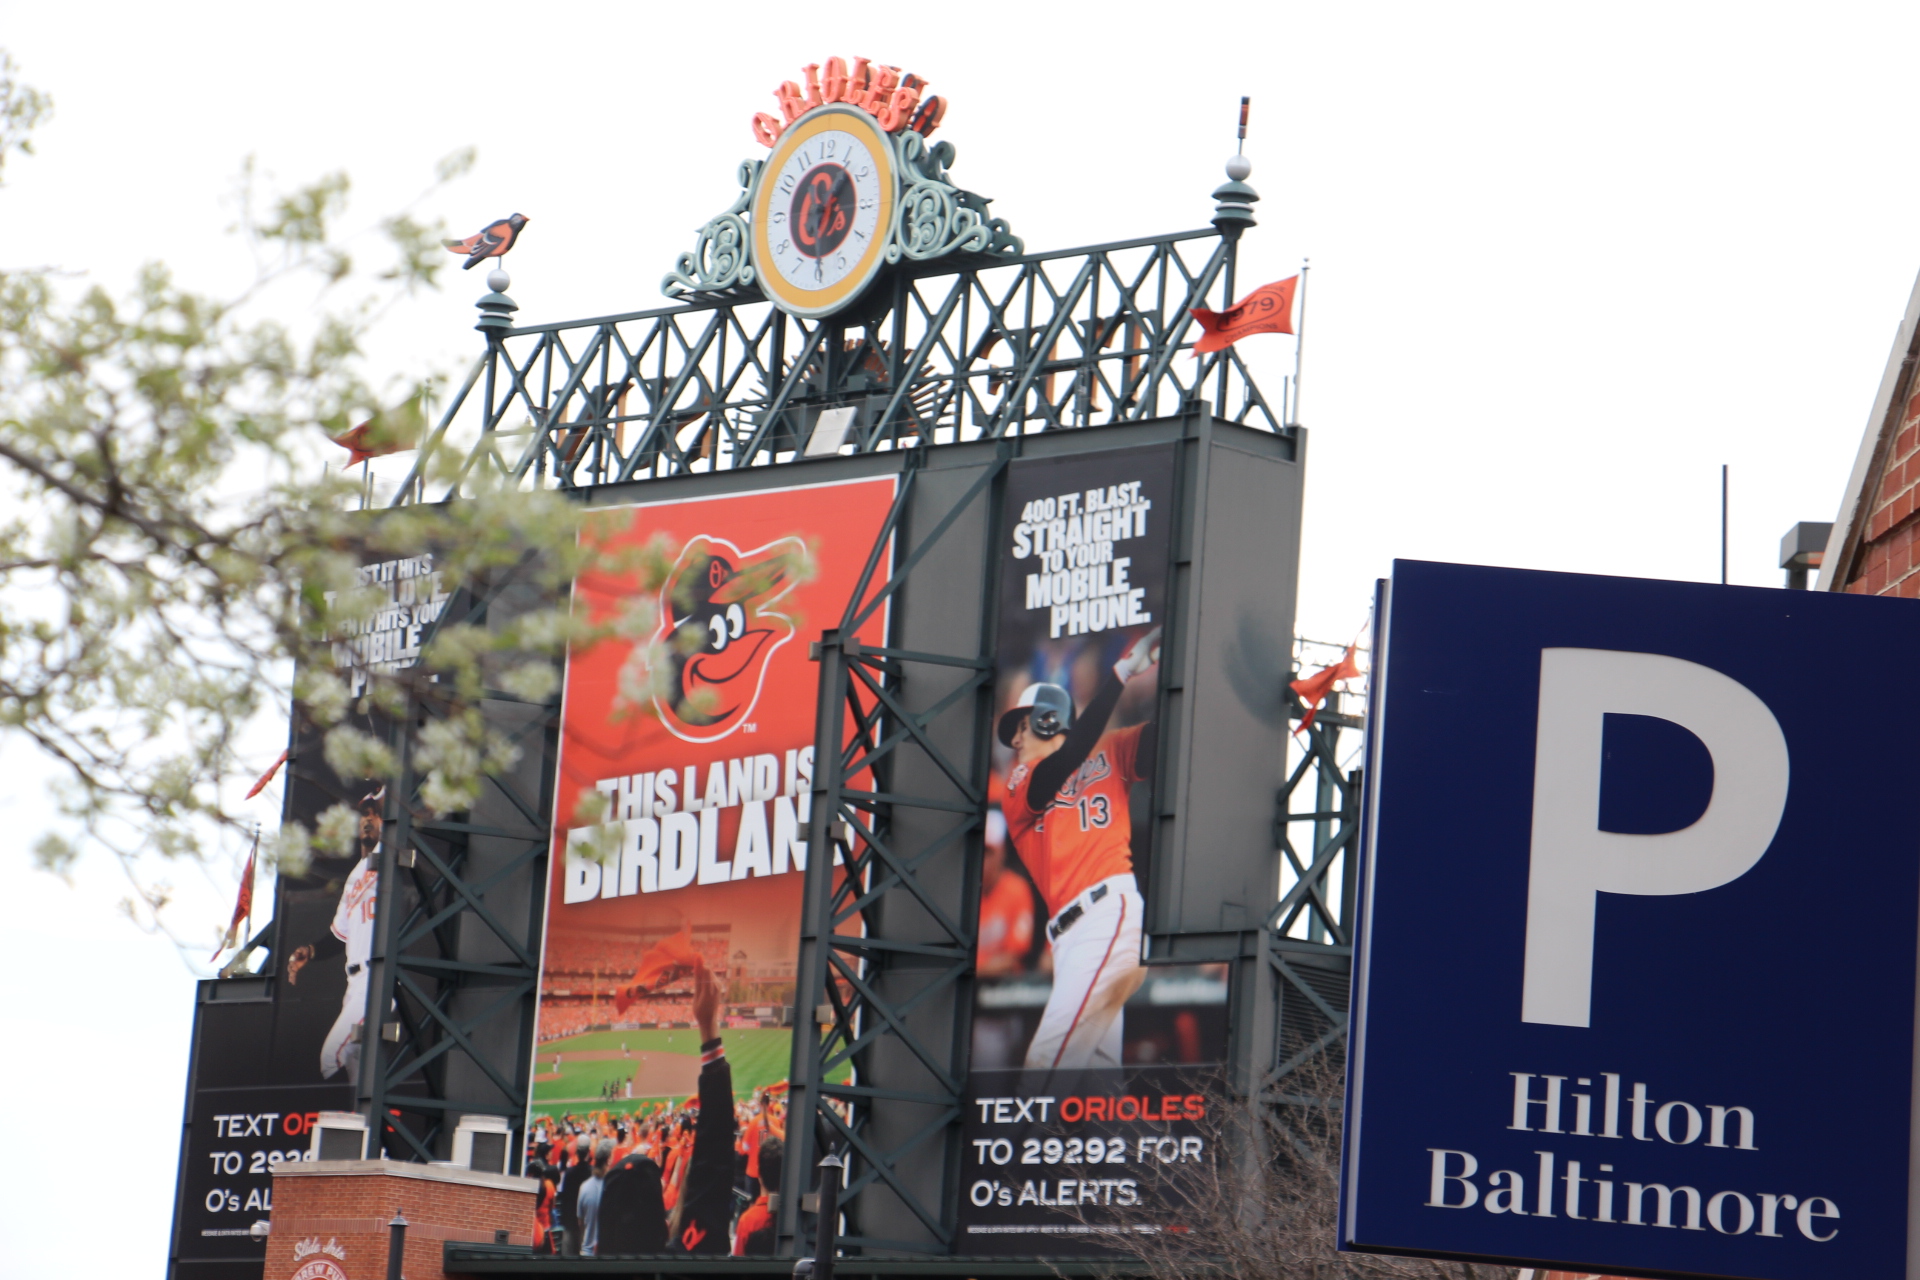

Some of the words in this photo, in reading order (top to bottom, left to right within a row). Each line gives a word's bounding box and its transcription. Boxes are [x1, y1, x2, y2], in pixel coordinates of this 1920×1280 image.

[752, 56, 920, 148] ORIOLES
[797, 150, 812, 172] 11
[819, 139, 836, 160] 12
[780, 174, 795, 196] 10
[855, 165, 869, 183] 2
[773, 210, 787, 224] 9
[858, 198, 873, 210] 3
[776, 239, 790, 255] 8
[853, 228, 866, 240] 4
[791, 256, 805, 275] 7
[836, 251, 847, 271] 5
[1021, 496, 1056, 524] 400
[1057, 492, 1084, 519] FT.
[1085, 480, 1146, 514] BLAST.
[1012, 499, 1151, 560] STRAIGHT
[398, 553, 433, 580] HITS
[1040, 549, 1064, 574] TO
[1066, 540, 1114, 570] YOUR
[1025, 556, 1131, 611] MOBILE
[375, 606, 410, 633] HITS
[412, 600, 447, 625] YOU
[1050, 587, 1151, 639] PHONE.
[743, 723, 758, 734] TM
[596, 768, 678, 824] THIS
[683, 752, 779, 812] LAND
[785, 745, 816, 799] IS
[1078, 792, 1112, 832] 13
[1521, 646, 1791, 1028] P
[976, 1096, 1055, 1124] TEXT
[1060, 1094, 1206, 1123] ORIOLES
[1506, 1071, 1760, 1151] Hilton
[213, 1113, 280, 1138] TEXT
[209, 1151, 243, 1175] TO
[972, 1137, 1014, 1166] TO
[1021, 1136, 1127, 1165] 29292
[1137, 1135, 1204, 1164] FOR
[205, 1188, 240, 1213] O's
[970, 1179, 1013, 1207] O's
[1017, 1178, 1143, 1207] ALERTS.
[1424, 1147, 1841, 1243] Baltimore
[293, 1236, 321, 1262] Slide
